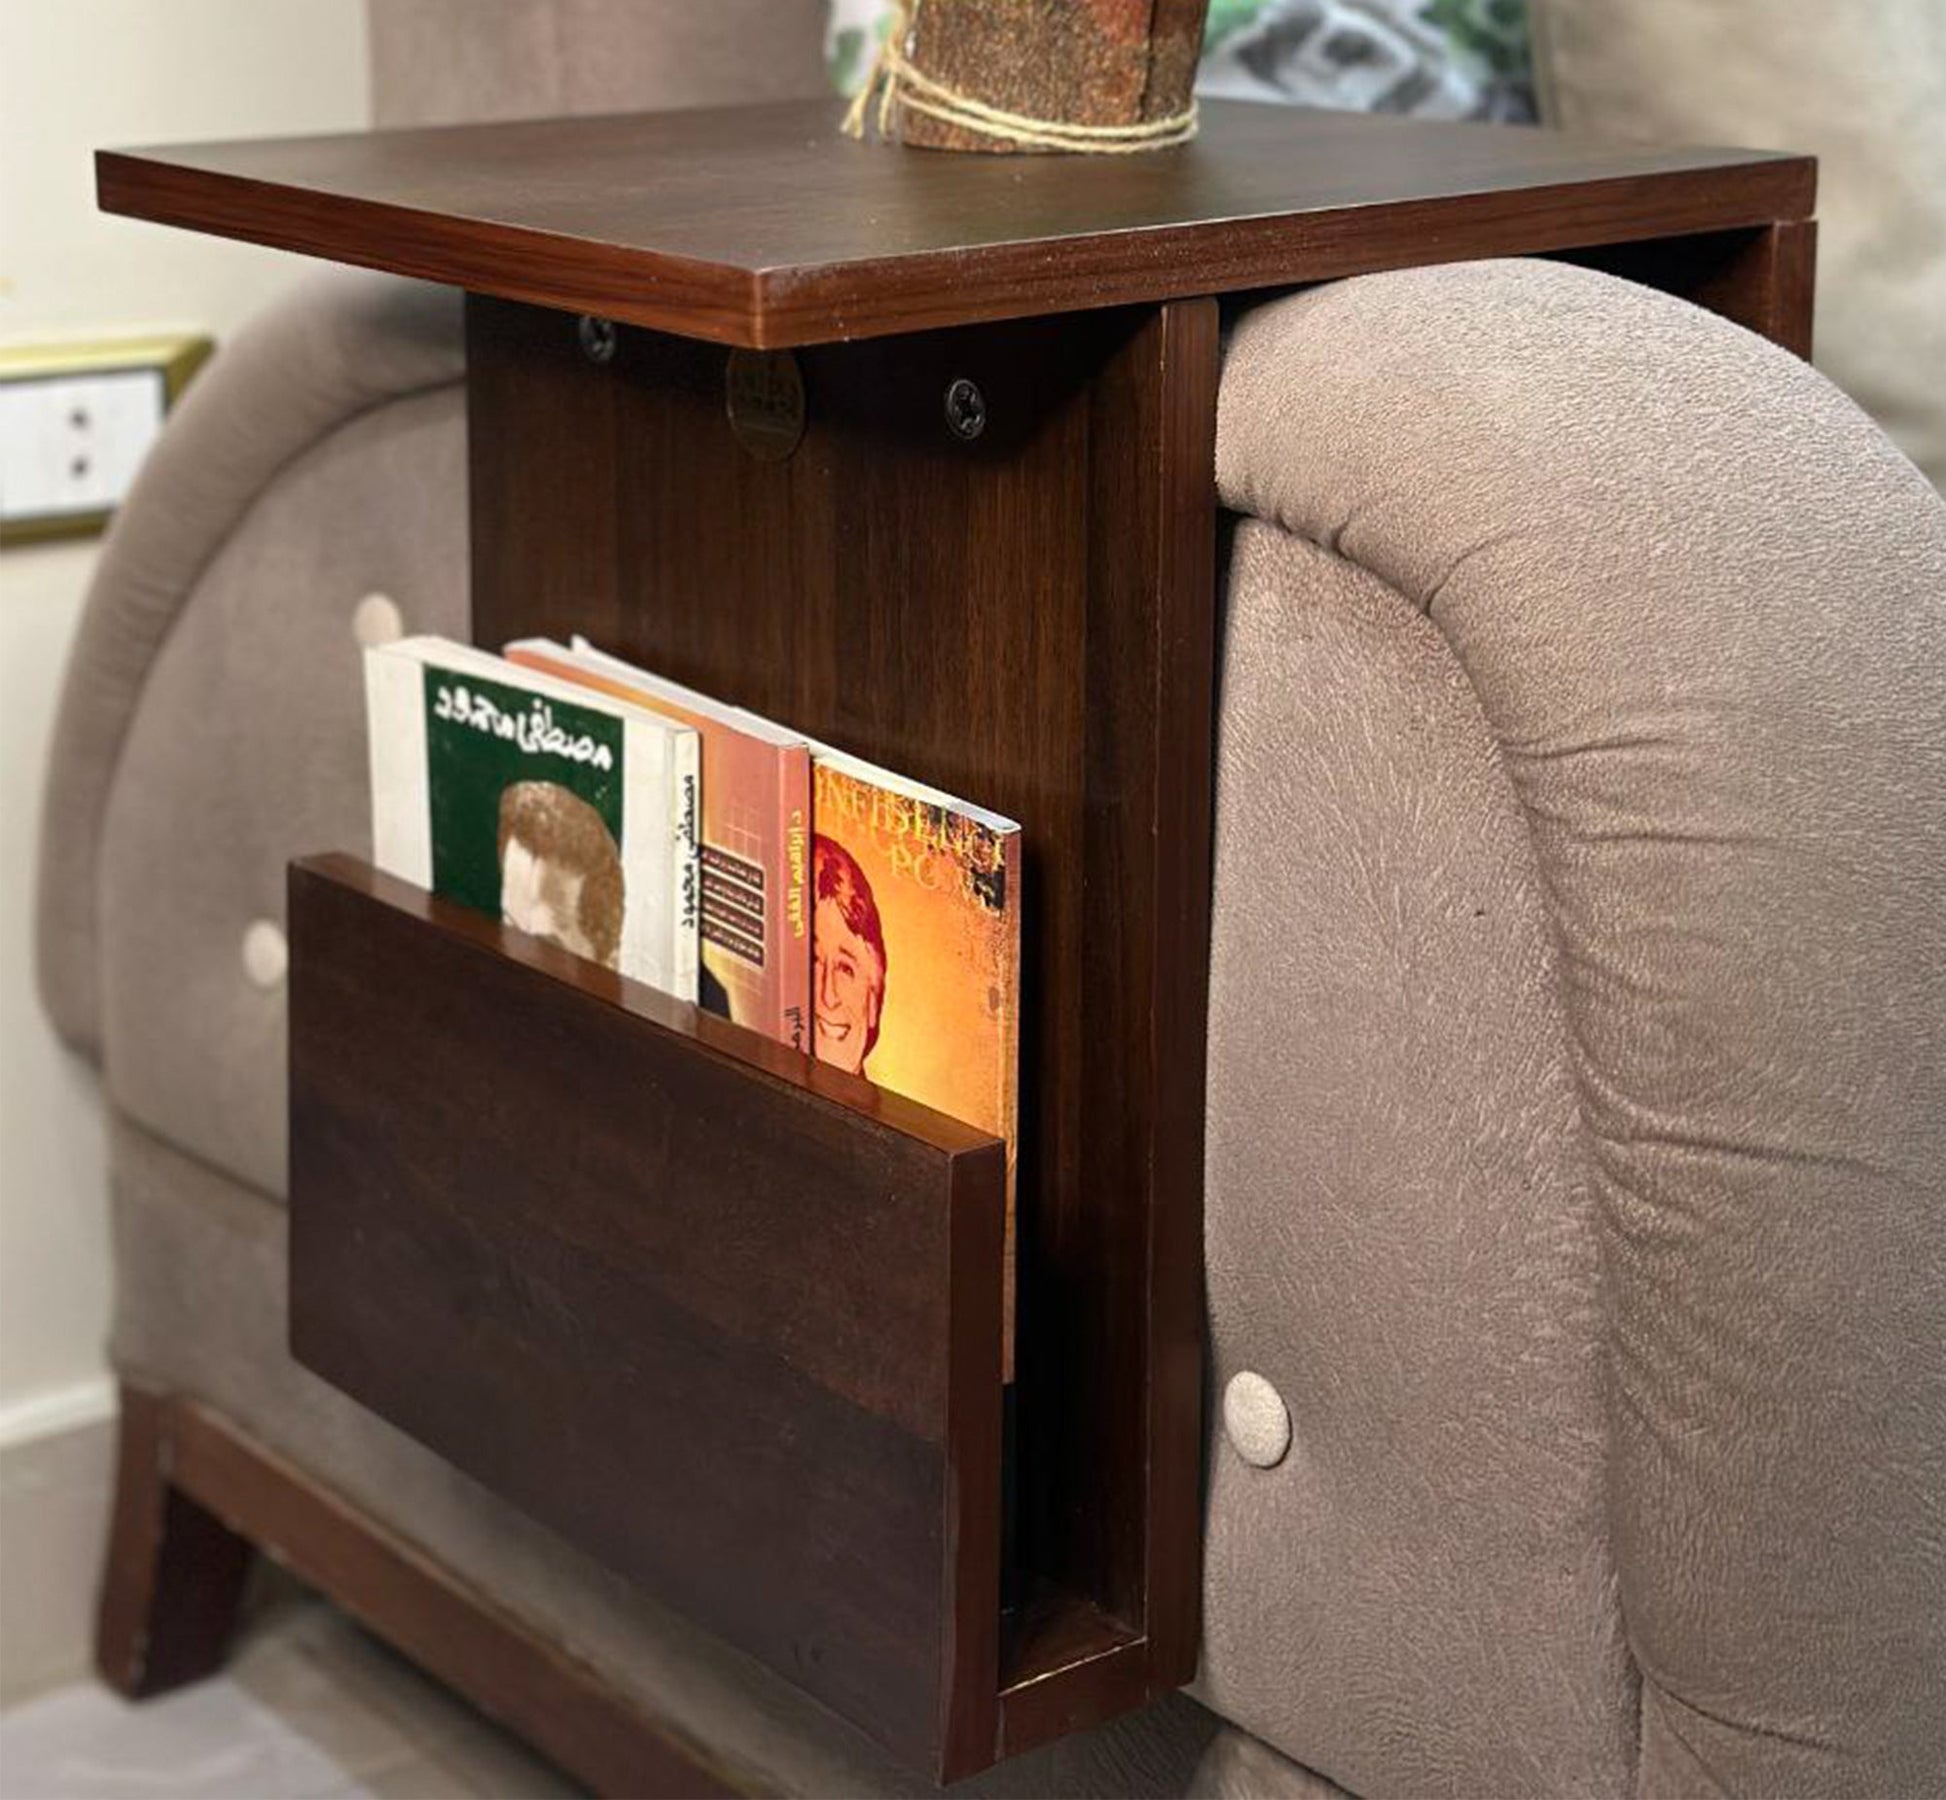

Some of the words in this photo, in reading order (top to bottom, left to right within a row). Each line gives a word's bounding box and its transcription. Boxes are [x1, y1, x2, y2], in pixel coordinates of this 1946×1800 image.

[434, 685, 516, 740] محمود
[516, 698, 613, 772] مصطفى
[681, 863, 697, 929] محمود
